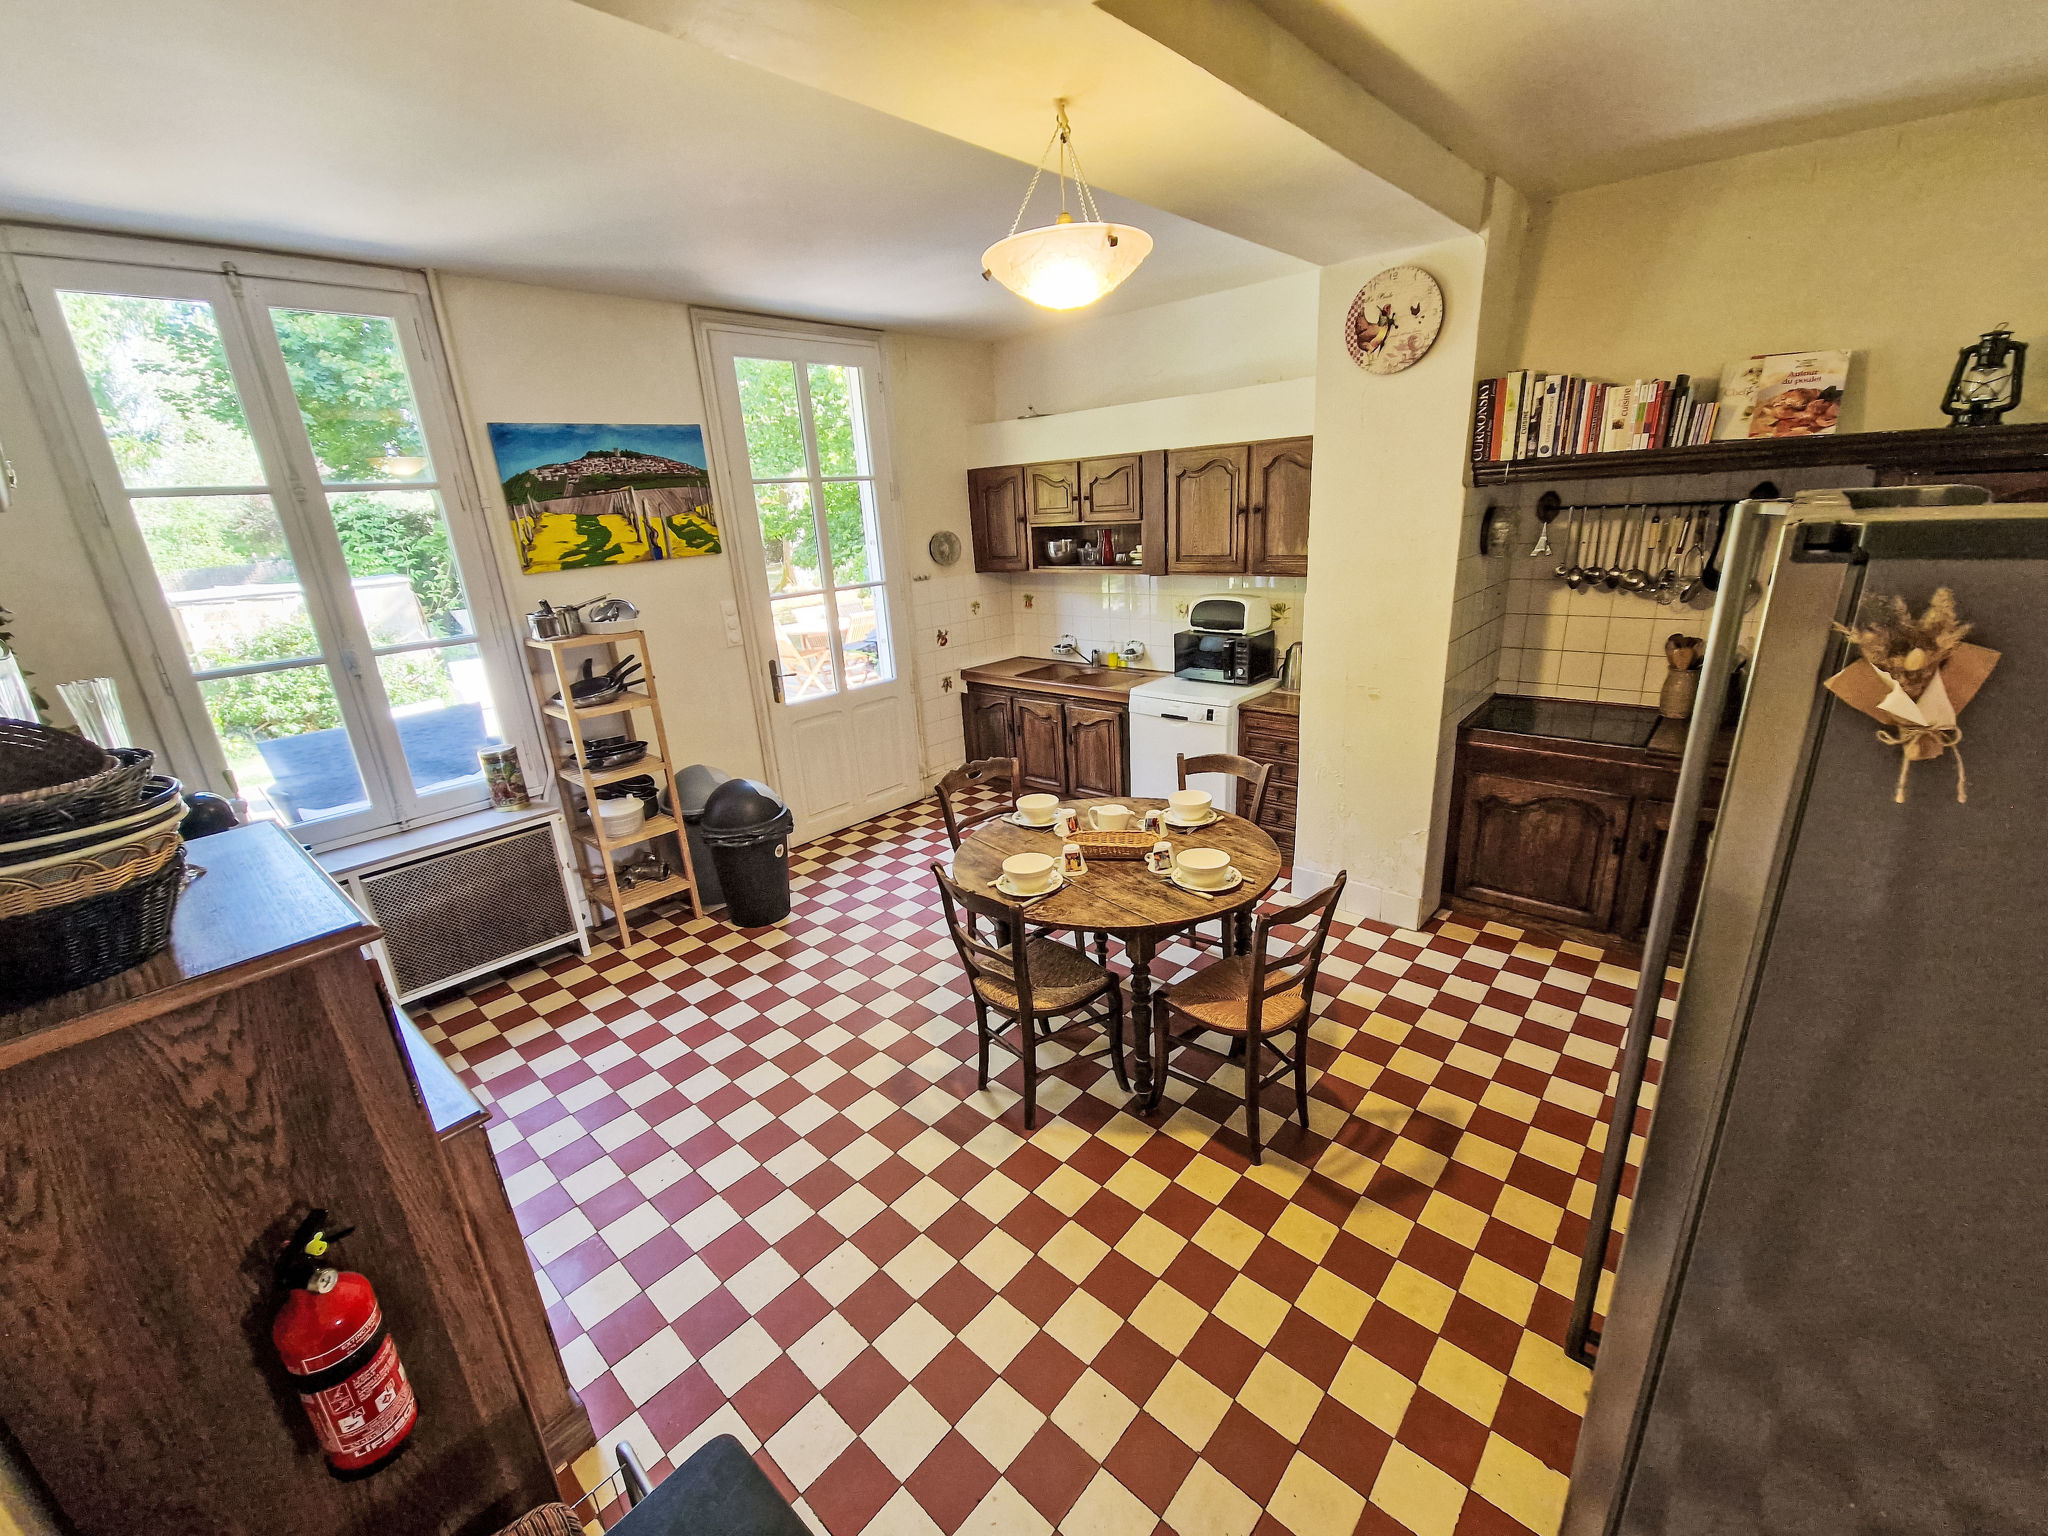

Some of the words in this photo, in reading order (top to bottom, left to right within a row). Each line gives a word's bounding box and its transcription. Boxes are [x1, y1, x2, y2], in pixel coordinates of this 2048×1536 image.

[1794, 376, 1822, 386] poulet
[1621, 387, 1632, 417] cuisine
[1472, 384, 1490, 461] CURNONSKY
[1520, 410, 1529, 435] CUISINE
